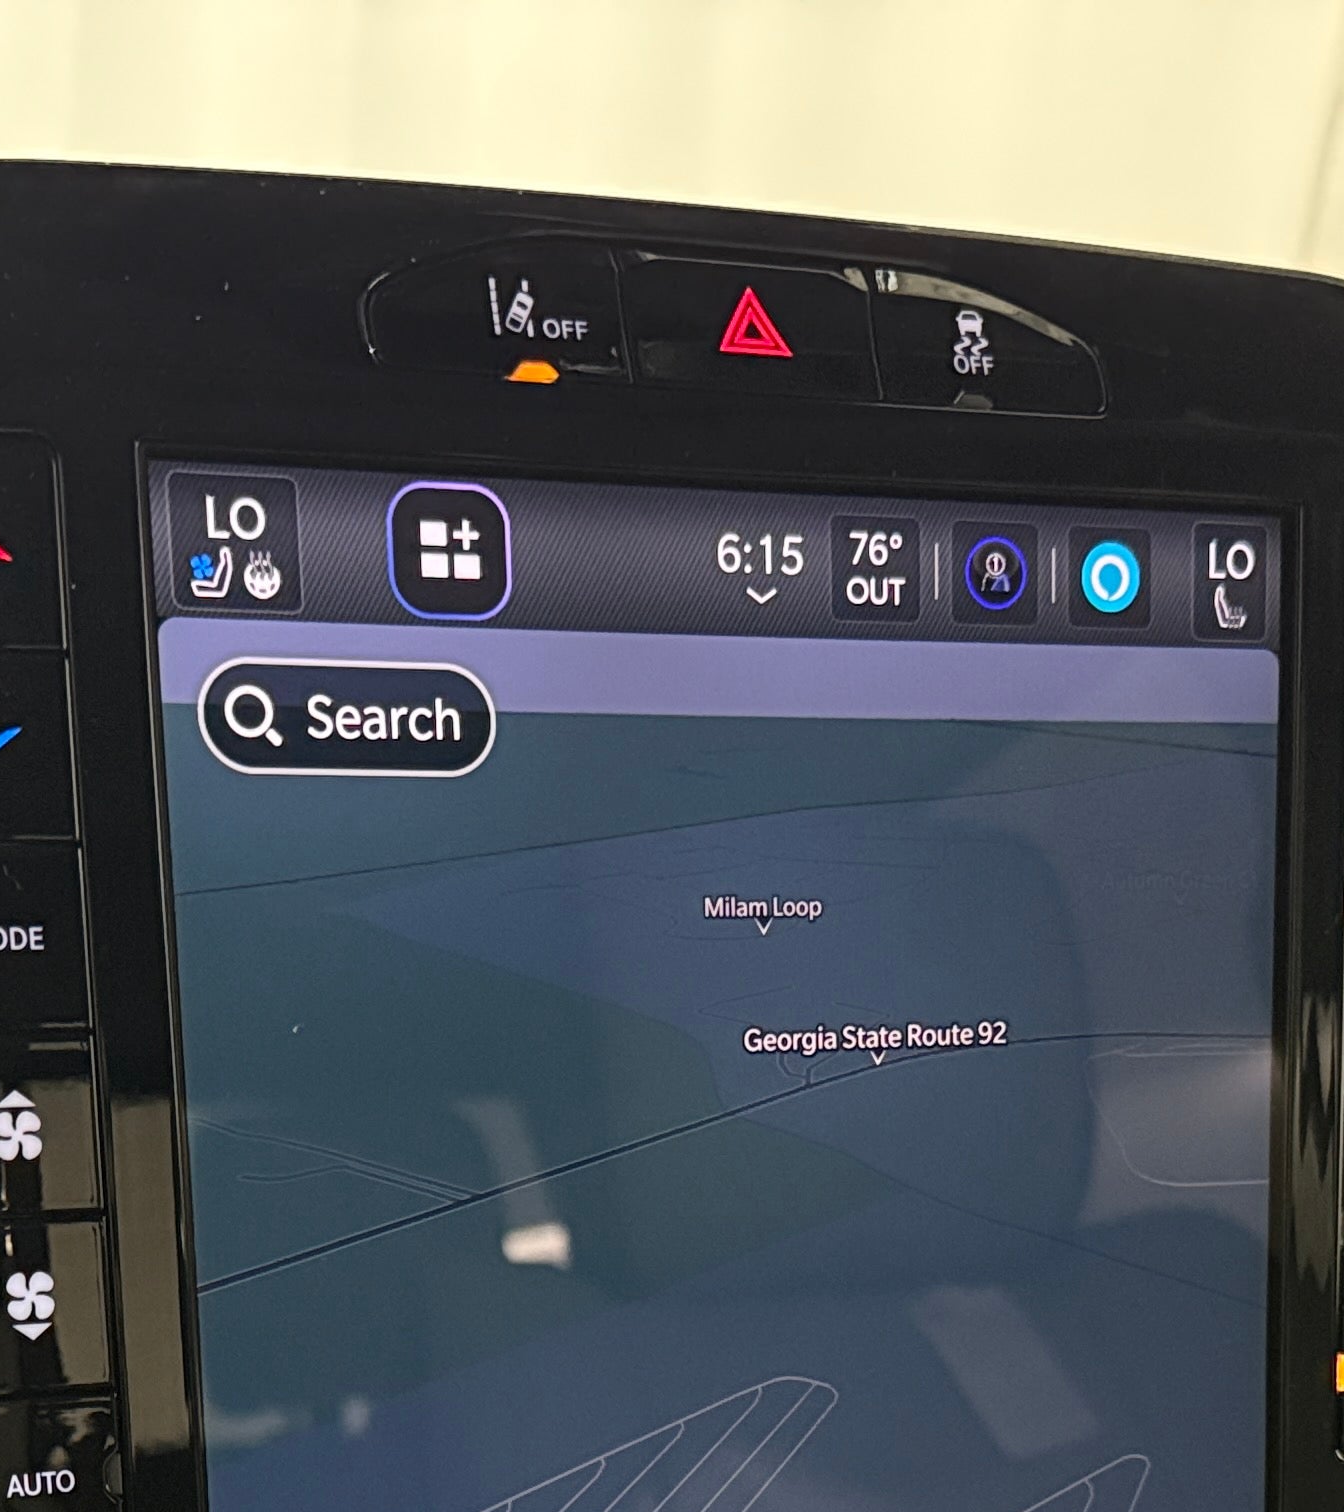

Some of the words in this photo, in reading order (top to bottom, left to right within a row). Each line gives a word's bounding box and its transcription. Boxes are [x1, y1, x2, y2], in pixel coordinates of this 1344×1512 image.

[542, 318, 588, 341] OFF
[953, 354, 994, 377] OFF
[205, 494, 266, 541] LO
[716, 532, 805, 576] 6:15
[849, 530, 903, 567] 76°
[1208, 537, 1255, 582] LO
[846, 575, 906, 608] OUT
[307, 694, 461, 742] Search
[704, 896, 768, 918] Milam
[773, 898, 822, 920] Loop
[743, 1025, 838, 1055] Georgia
[842, 1024, 902, 1050] State
[907, 1023, 974, 1047] Route
[977, 1021, 1007, 1045] 92
[6, 1470, 75, 1498] AUTO
